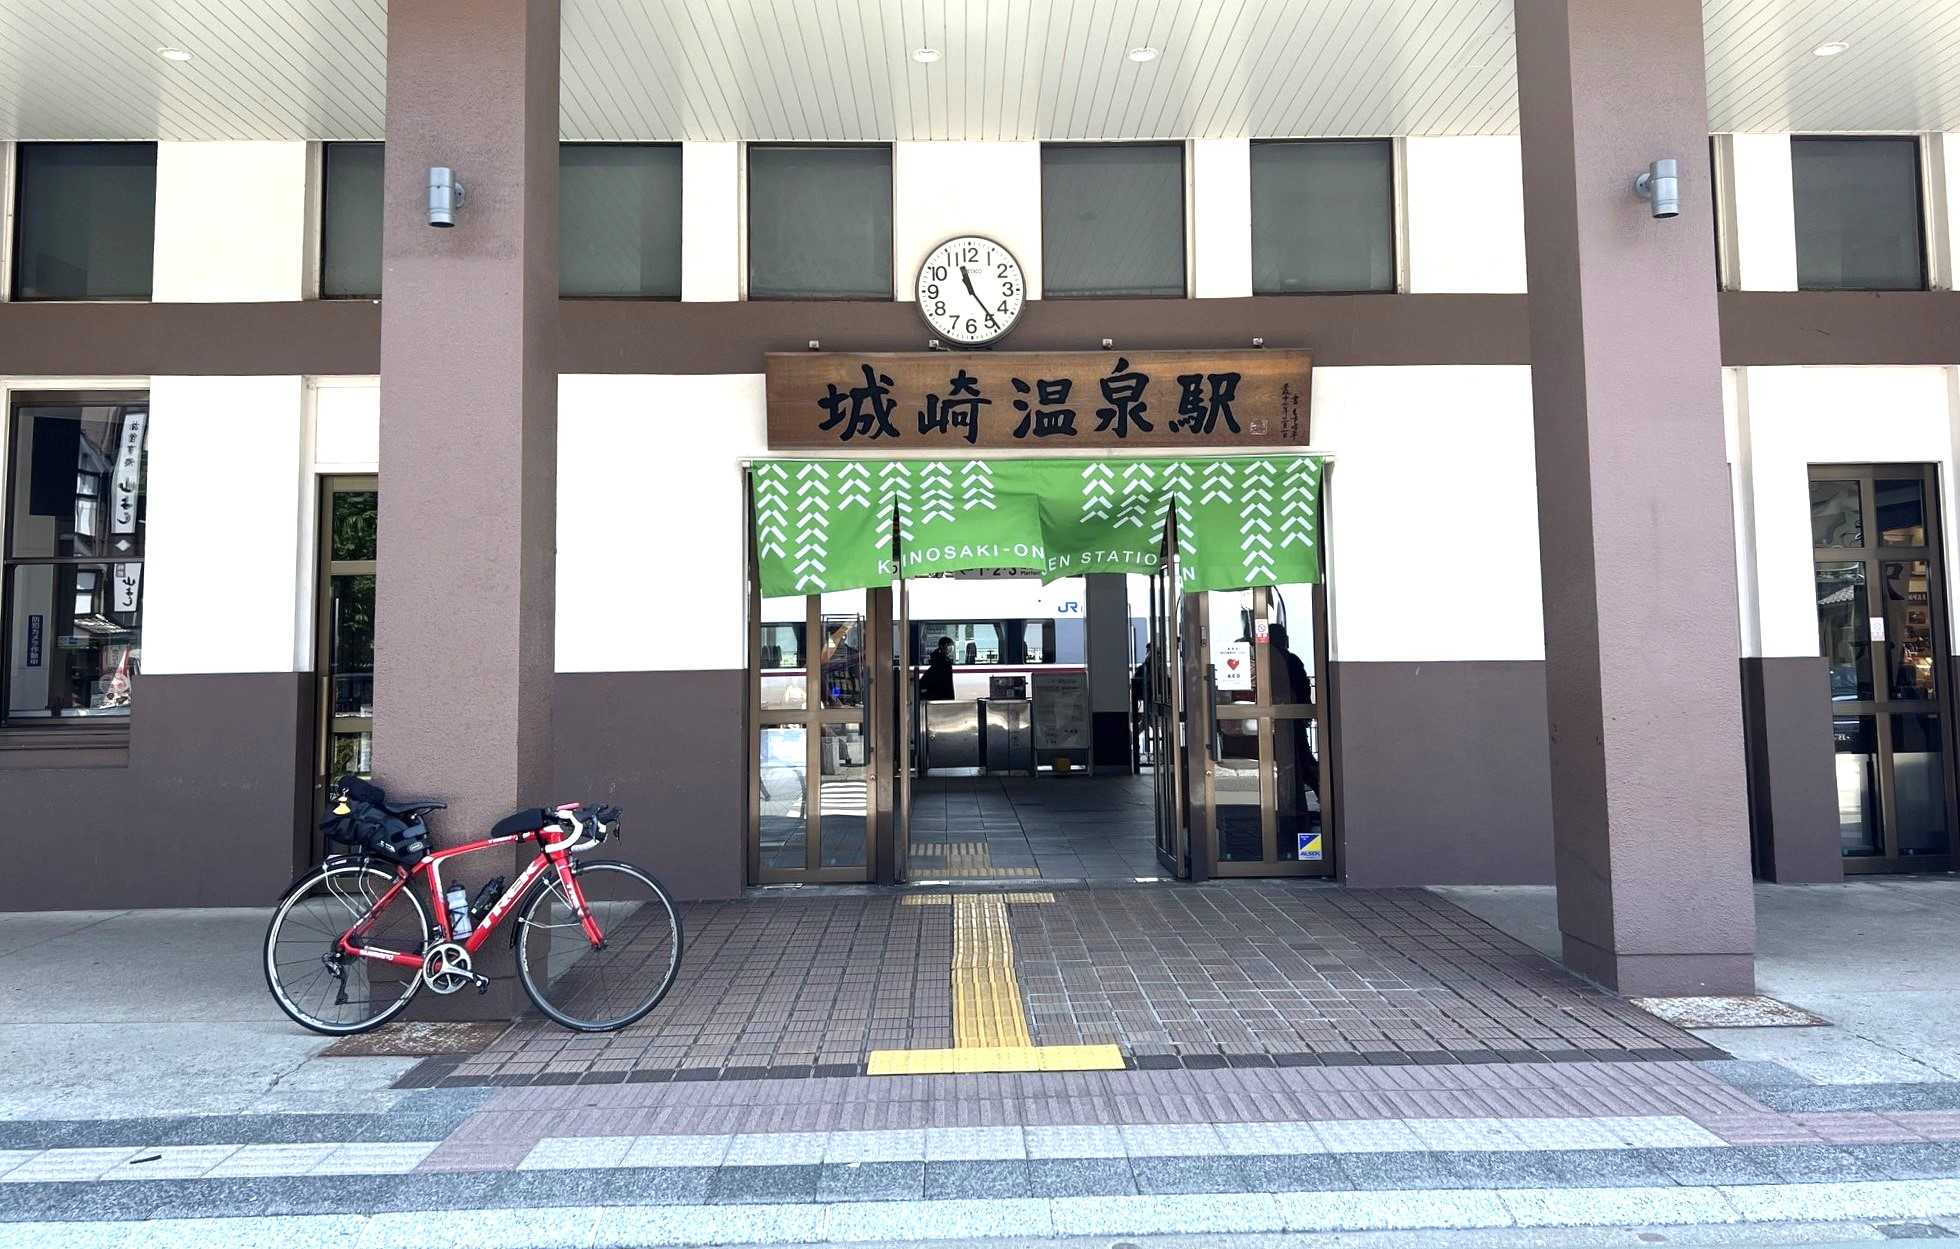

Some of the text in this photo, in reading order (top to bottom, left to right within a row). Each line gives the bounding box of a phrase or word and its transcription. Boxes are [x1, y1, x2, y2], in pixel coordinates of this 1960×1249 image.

[947, 251, 959, 267] 11
[962, 247, 979, 263] 12
[932, 265, 948, 281] 10
[996, 263, 1008, 278] 2
[927, 284, 939, 300] 9
[1002, 281, 1014, 297] 3
[934, 300, 946, 316] 8
[996, 299, 1009, 315] 4
[949, 315, 960, 330] 7
[965, 318, 978, 334] 6
[984, 313, 996, 329] 5
[817, 357, 1242, 444] 城崎温泉駅
[1058, 601, 1078, 613] JR
[477, 860, 538, 930] TREK
